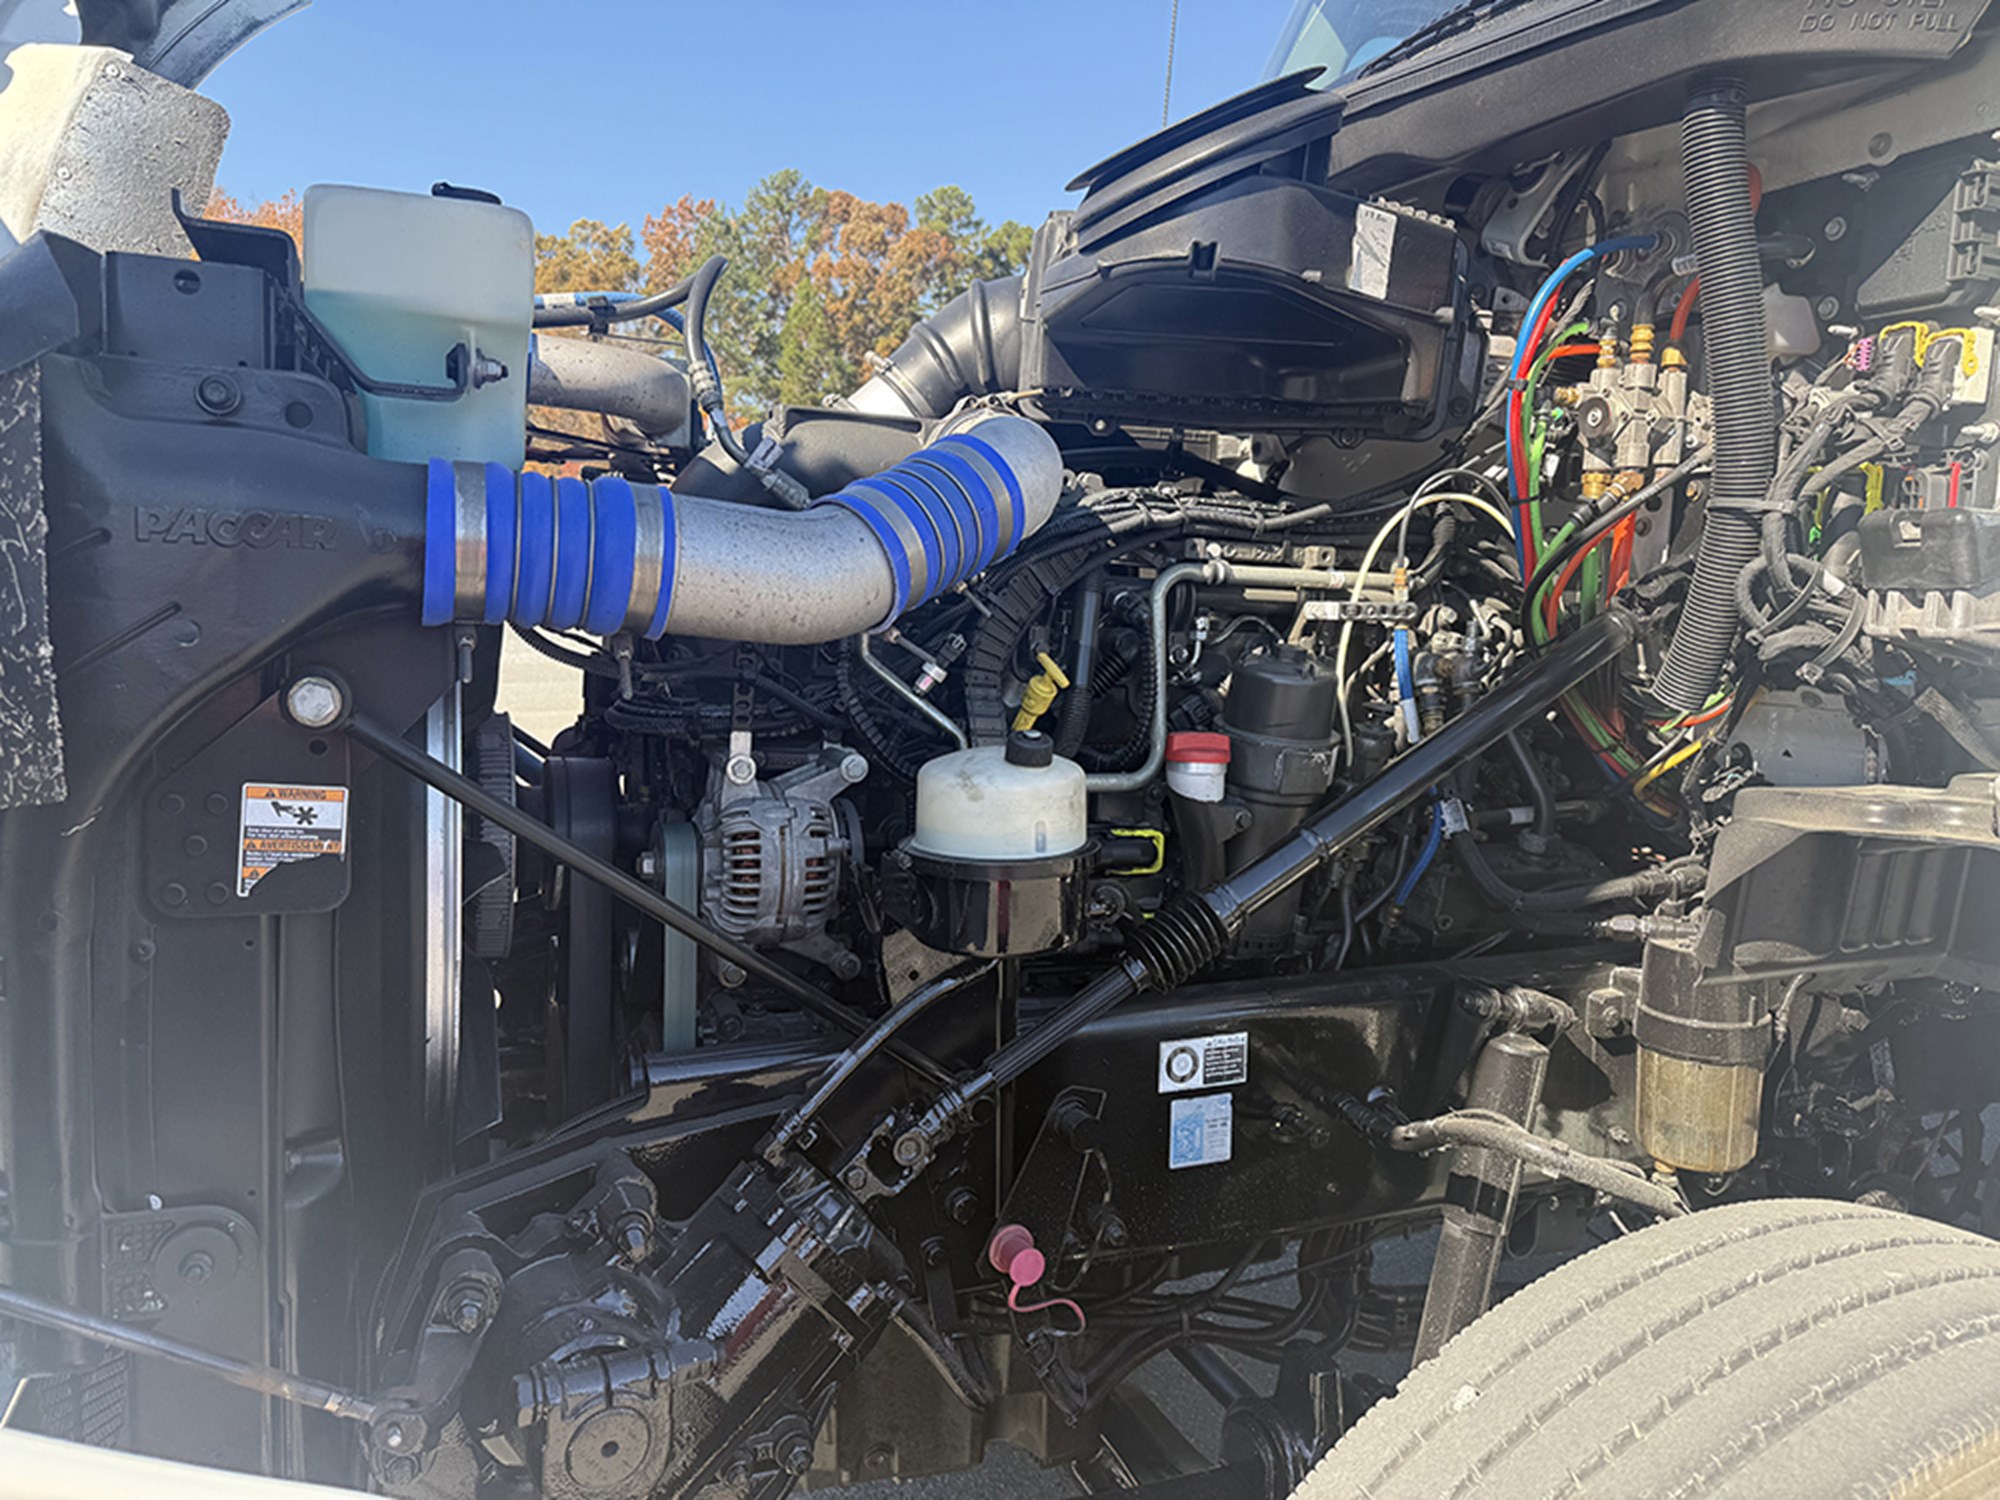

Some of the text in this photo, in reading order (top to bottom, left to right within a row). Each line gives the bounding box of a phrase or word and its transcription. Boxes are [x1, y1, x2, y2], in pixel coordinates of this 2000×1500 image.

[1800, 11, 1958, 33] DO NOT PULL
[134, 505, 337, 549] PACCAR
[278, 788, 327, 800] WARNING
